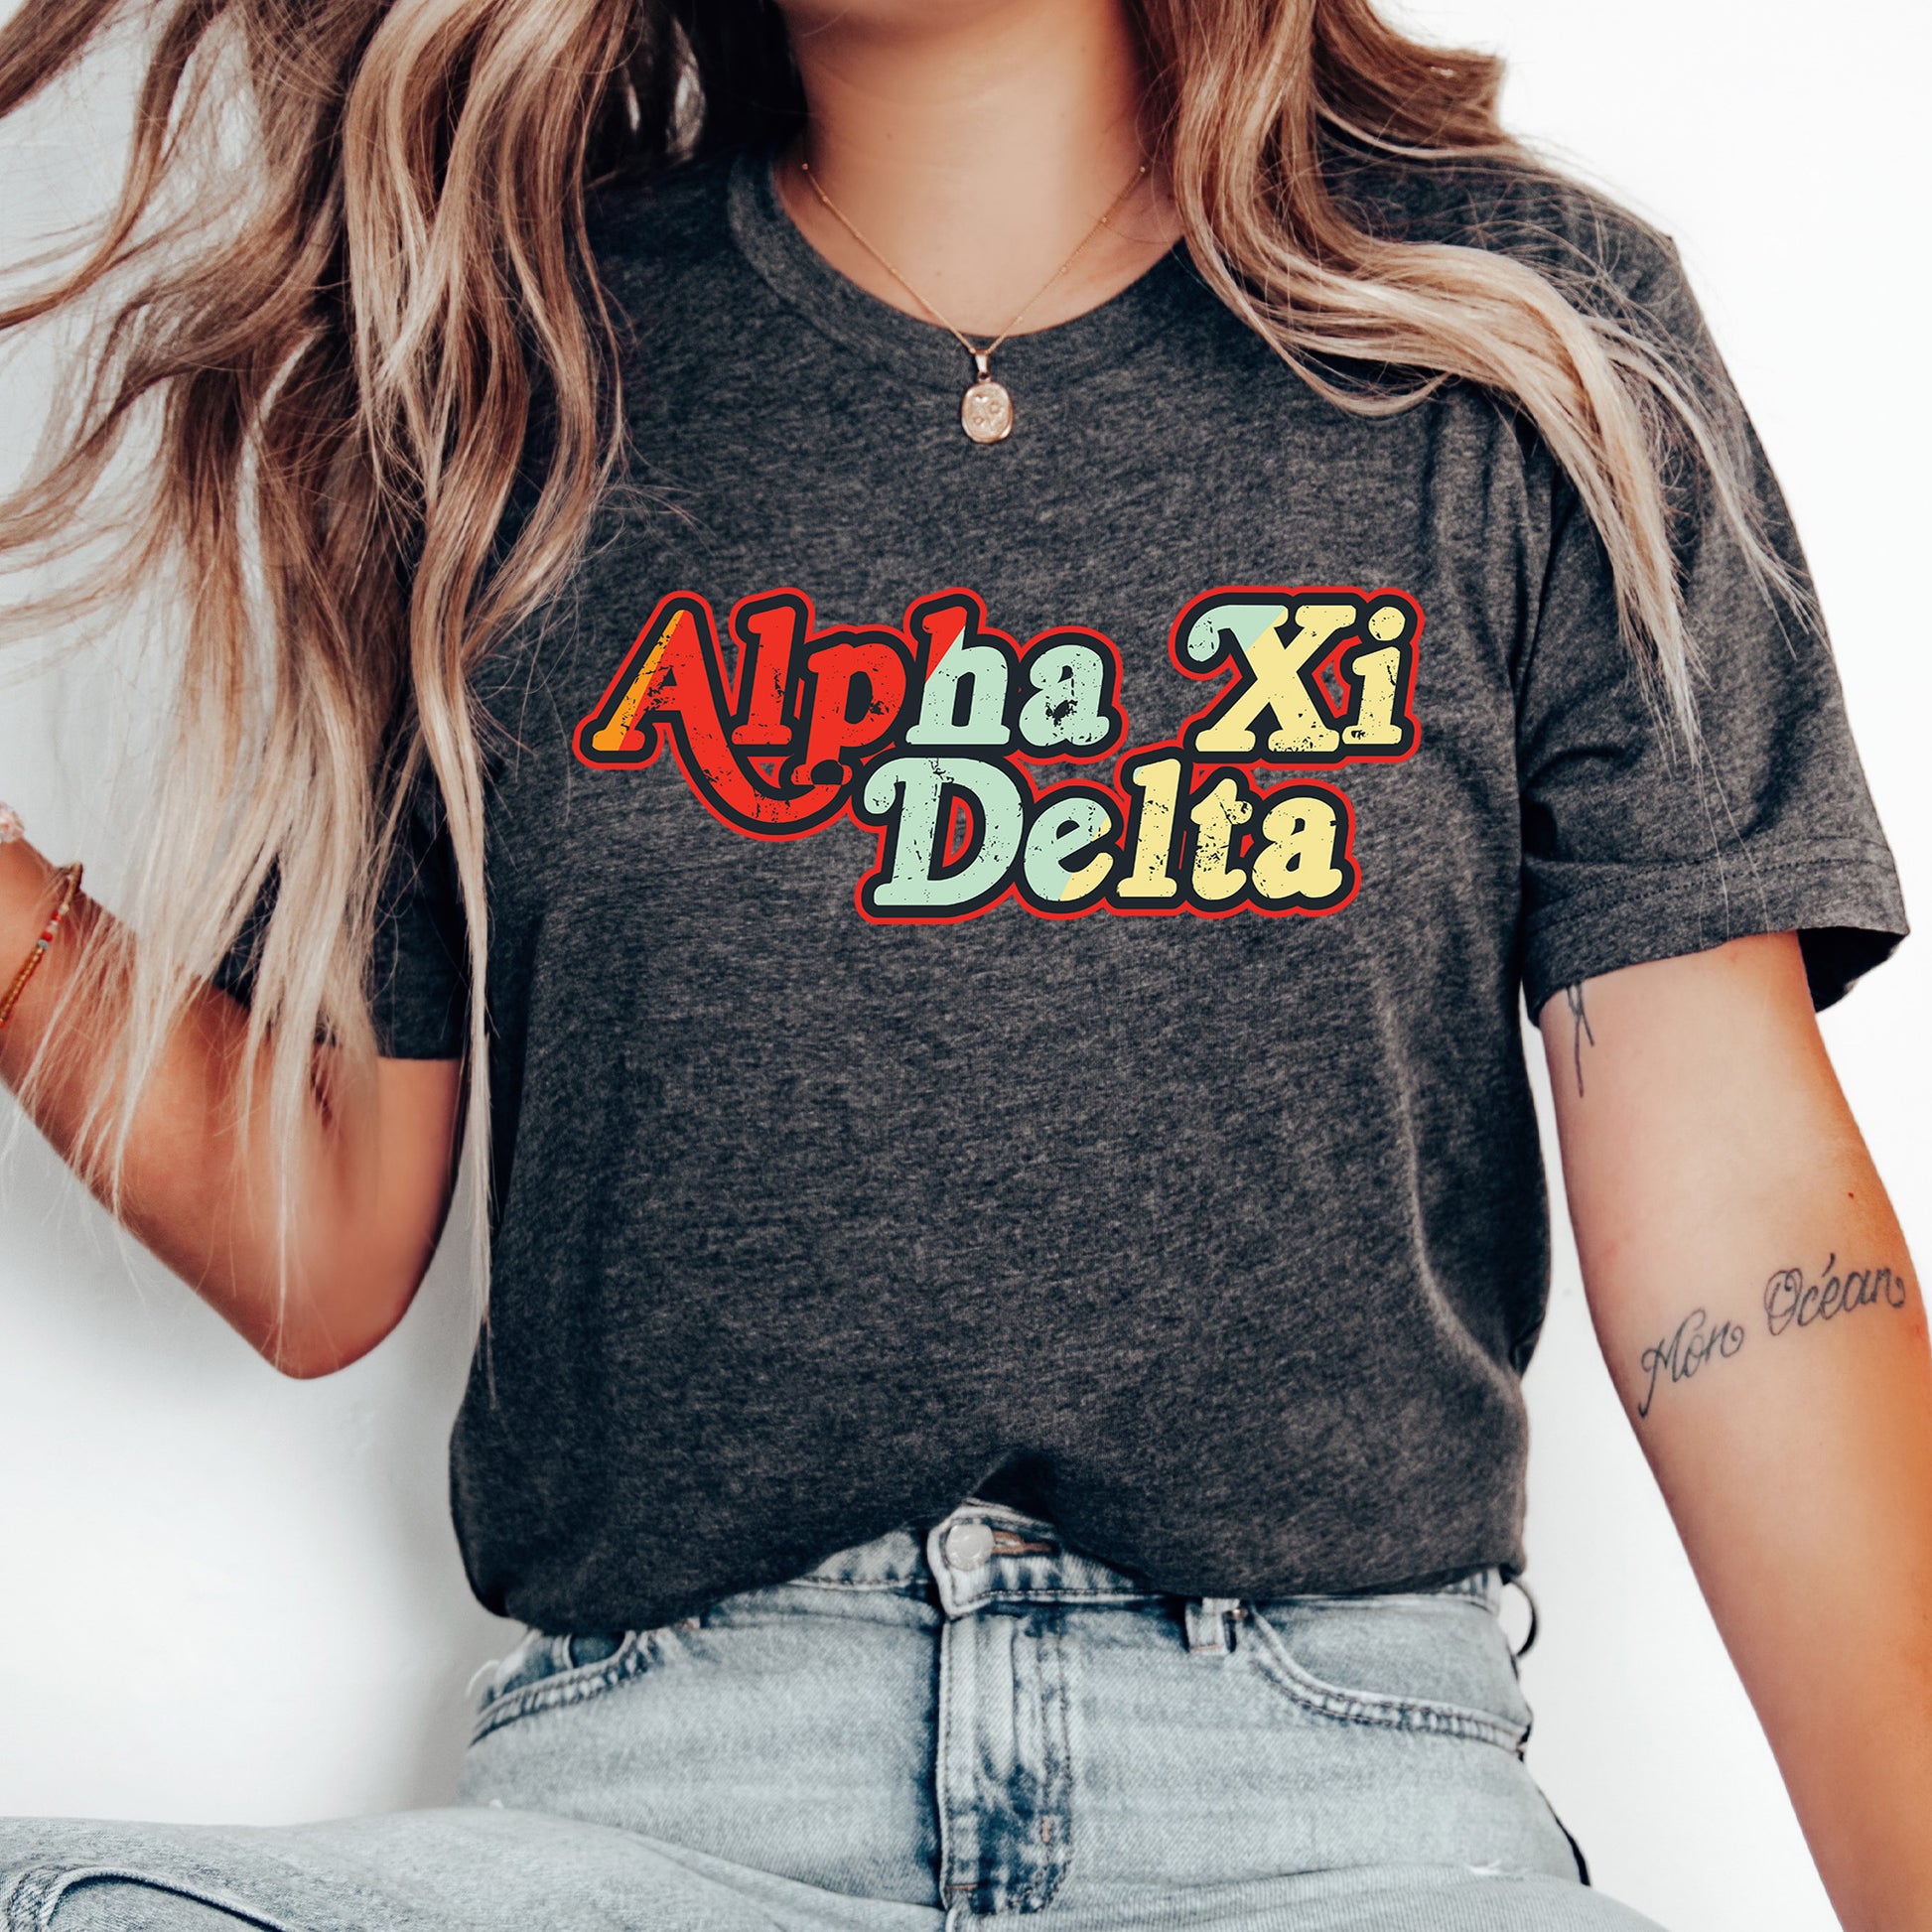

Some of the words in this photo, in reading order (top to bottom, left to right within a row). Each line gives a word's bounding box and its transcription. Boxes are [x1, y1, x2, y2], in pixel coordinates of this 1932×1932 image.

[591, 604, 1111, 825] Alpha
[1185, 603, 1408, 754] Xi
[862, 754, 1343, 907] Delta
[1638, 1308, 1744, 1418] Mon
[1763, 1252, 1906, 1336] Océan
